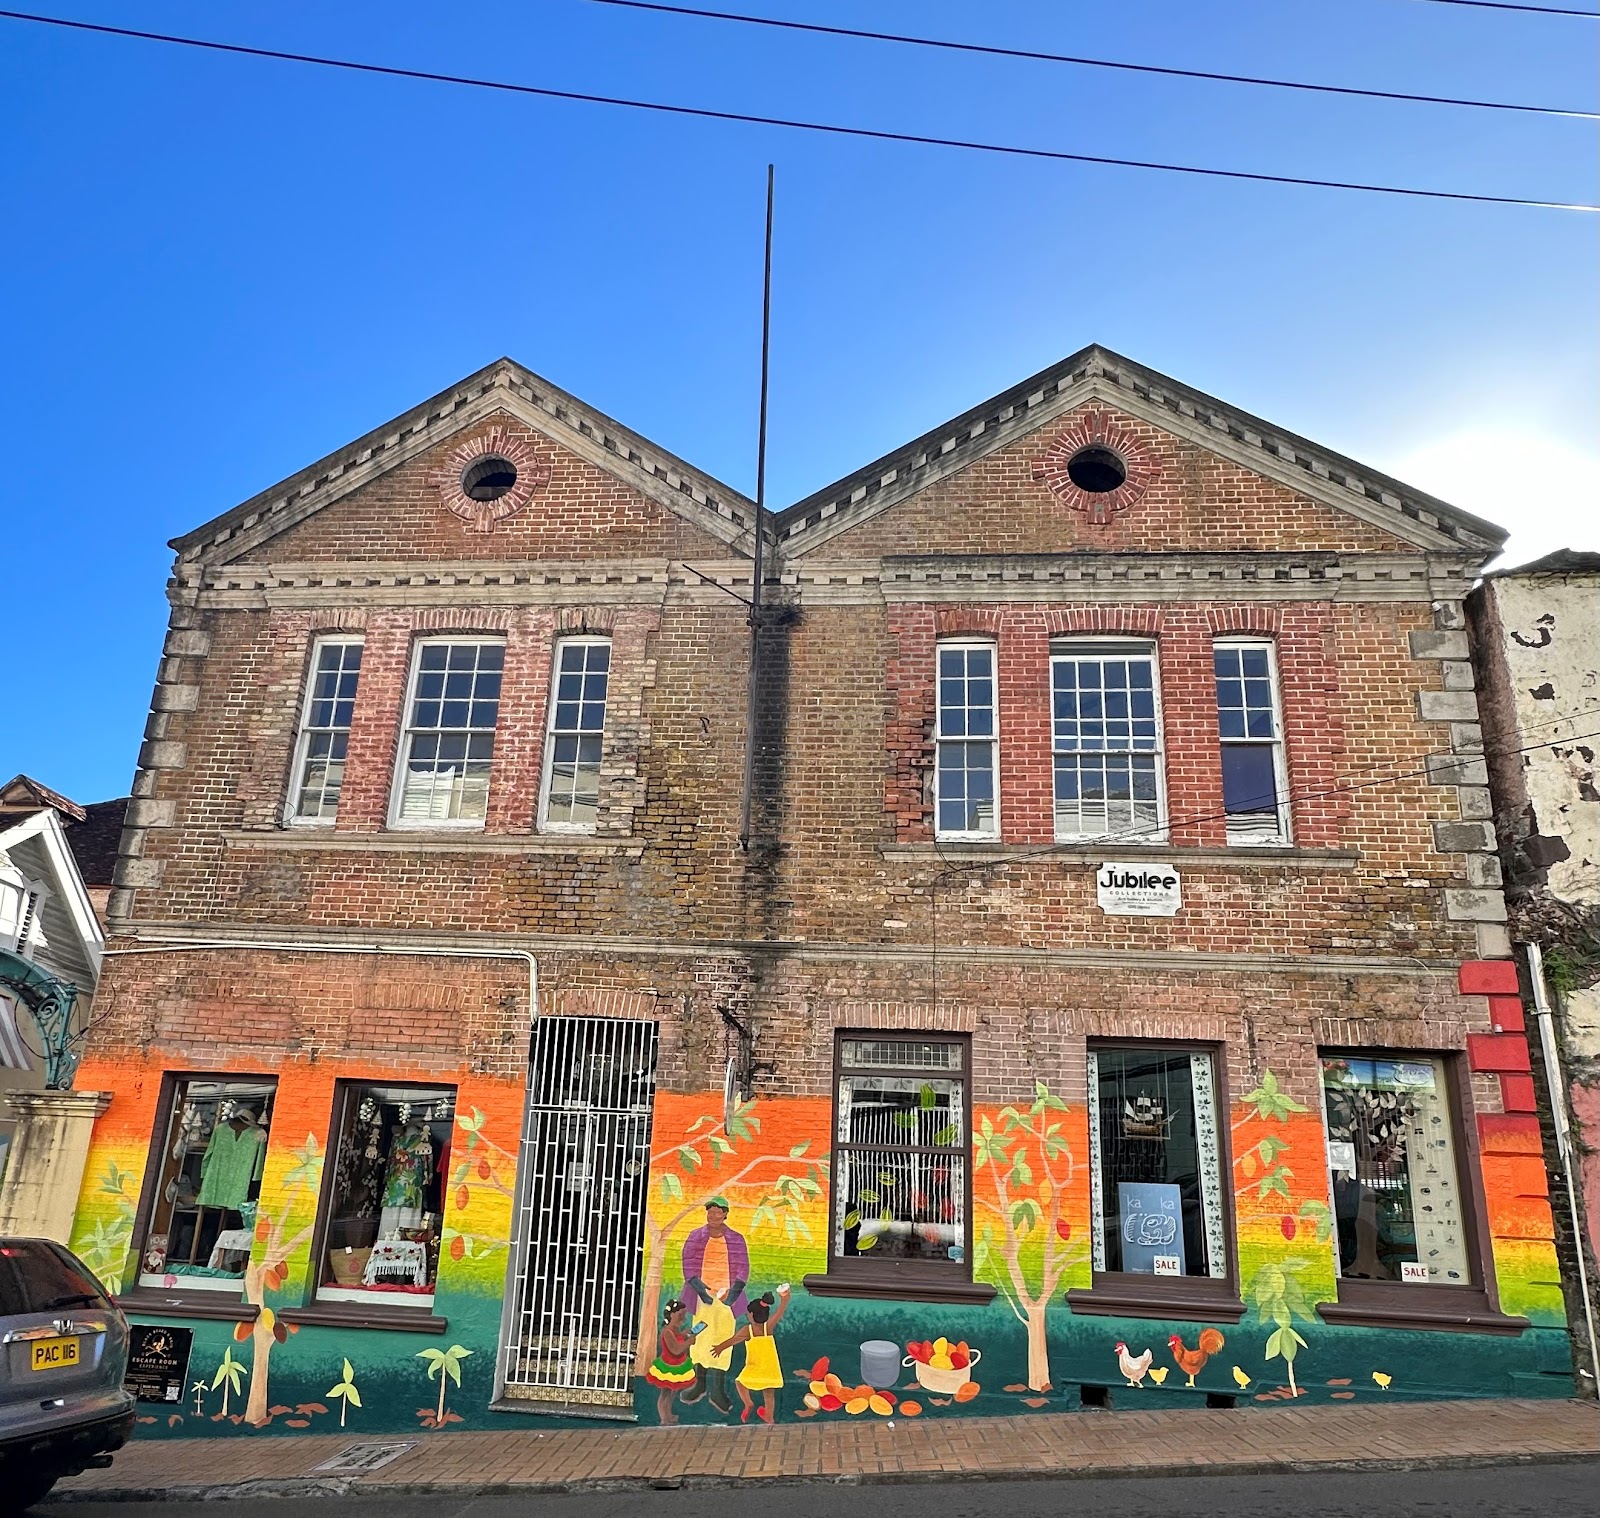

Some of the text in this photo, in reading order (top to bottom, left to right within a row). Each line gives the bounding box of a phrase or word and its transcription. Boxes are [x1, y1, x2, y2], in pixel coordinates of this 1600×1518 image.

[1100, 867, 1177, 889] Jubilee
[1155, 1259, 1177, 1270] SALE
[1403, 1266, 1427, 1277] SALE
[36, 1343, 76, 1364] PAC 116
[131, 1356, 178, 1366] ESCAPE ROOM
